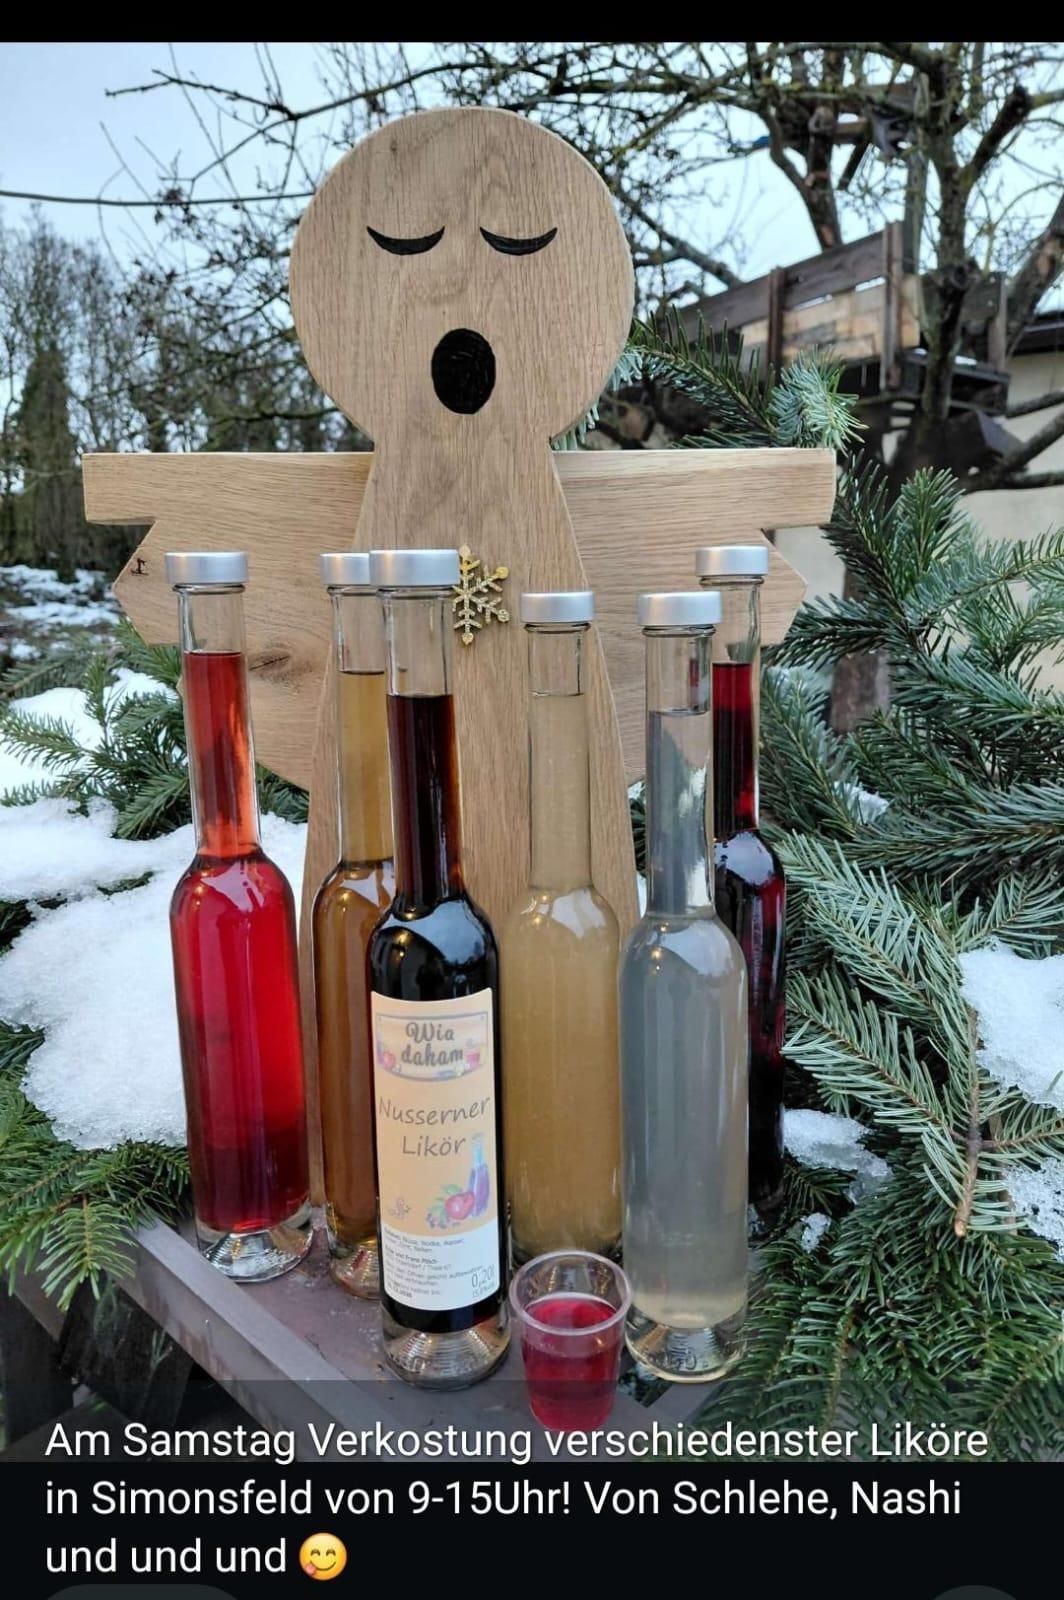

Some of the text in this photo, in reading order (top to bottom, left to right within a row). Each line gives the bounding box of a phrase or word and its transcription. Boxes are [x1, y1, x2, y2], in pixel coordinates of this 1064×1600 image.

[405, 1021, 455, 1043] Wia
[401, 1042, 464, 1067] daham
[378, 1095, 491, 1126] Nusserner
[402, 1135, 467, 1157] Likör
